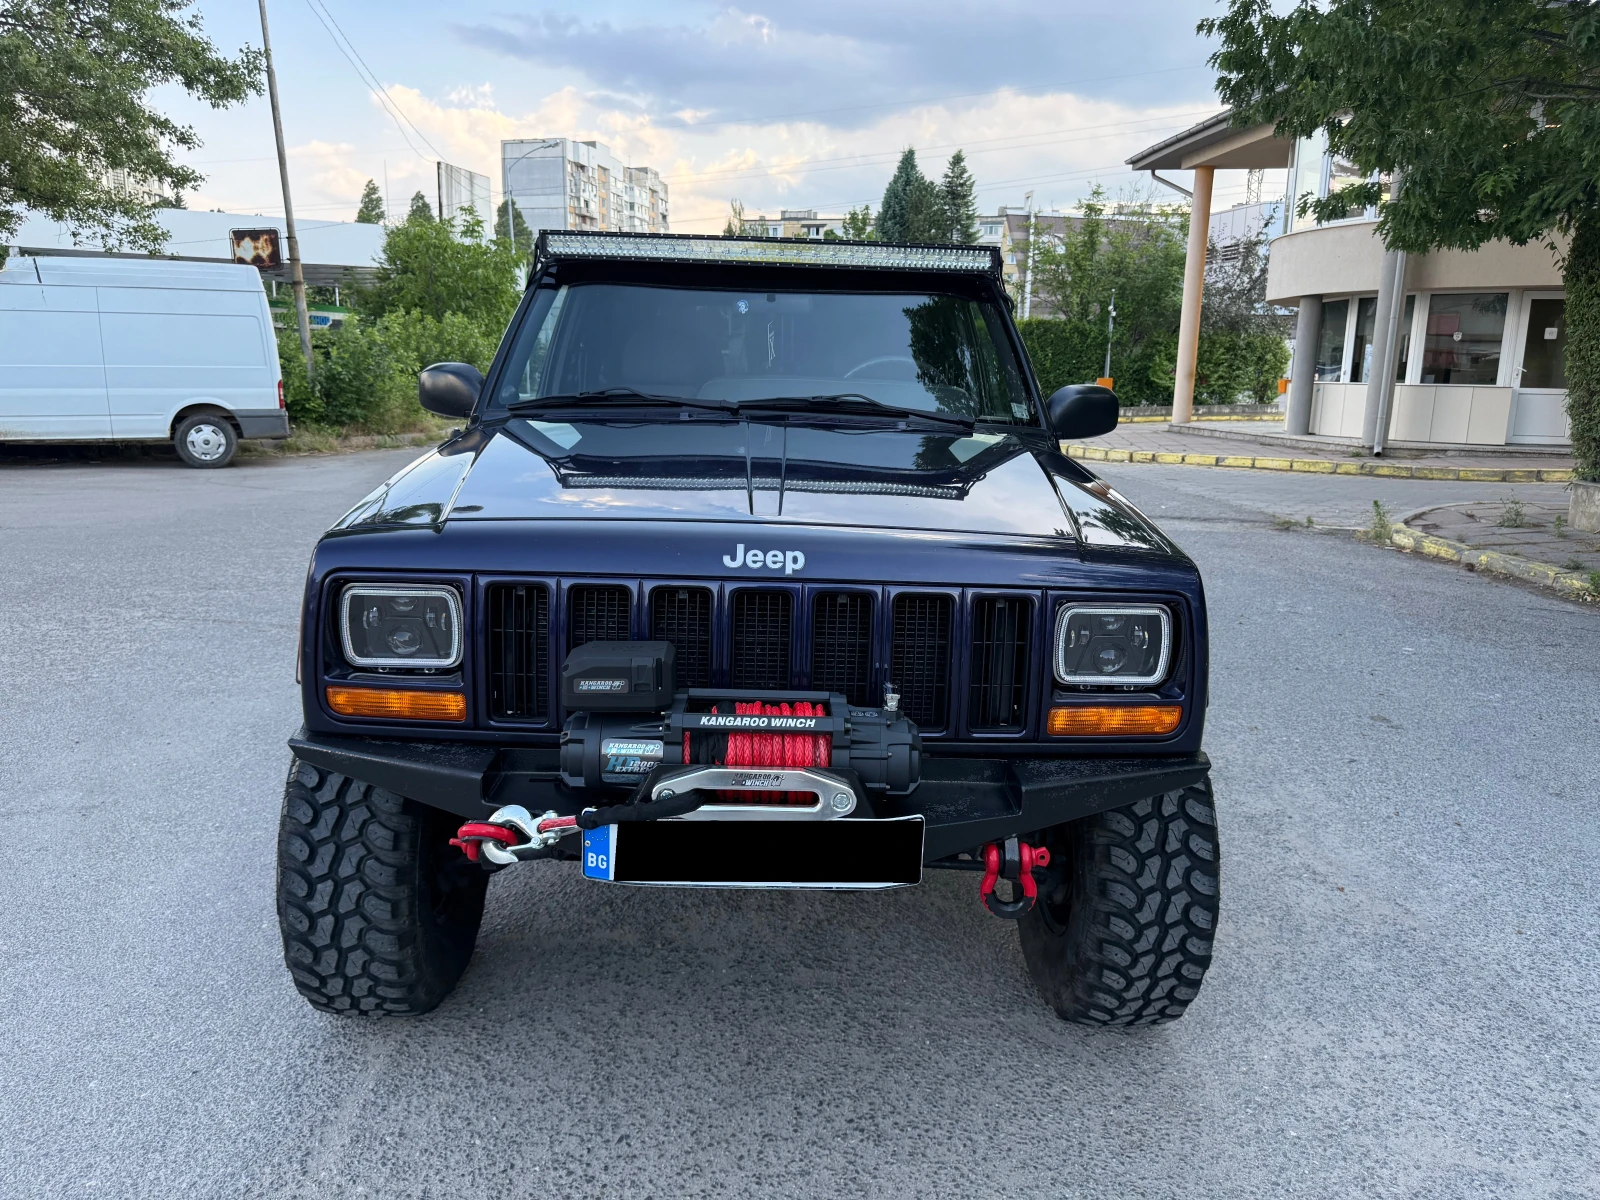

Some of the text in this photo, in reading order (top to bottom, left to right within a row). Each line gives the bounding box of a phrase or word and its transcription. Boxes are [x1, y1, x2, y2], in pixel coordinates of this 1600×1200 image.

[722, 543, 806, 575] Jeep
[700, 716, 816, 728] KANGAROO WINCH
[587, 852, 607, 869] BG
